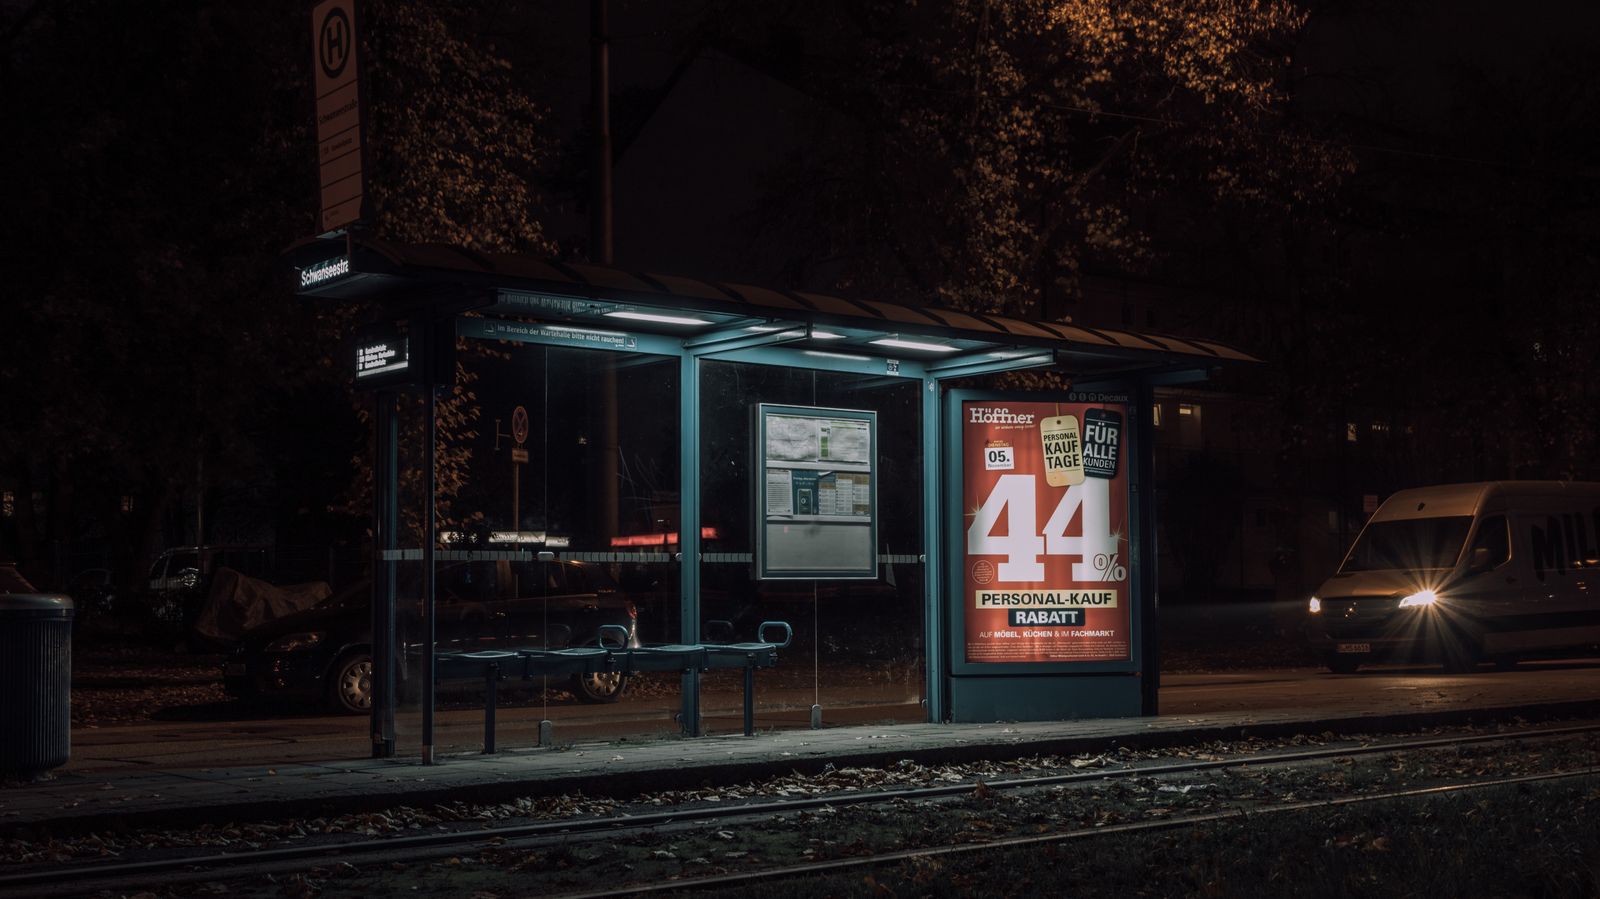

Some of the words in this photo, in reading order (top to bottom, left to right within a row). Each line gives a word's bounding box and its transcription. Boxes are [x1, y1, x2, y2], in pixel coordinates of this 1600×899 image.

[497, 323, 506, 331] Im
[506, 325, 528, 335] Bereich
[529, 327, 539, 335] der
[540, 328, 571, 339] Wartehalle
[572, 332, 585, 340] bitte
[586, 333, 600, 342] nicht
[1098, 393, 1129, 402] Decaux
[969, 408, 1035, 424] Höffner
[1043, 432, 1078, 442] PERSONAL
[1085, 422, 1118, 445] FÜR
[1045, 440, 1078, 456] KAUF
[1083, 443, 1117, 460] ALLE
[988, 450, 1010, 463] 05.
[1046, 454, 1081, 469] TAGE
[1083, 457, 1116, 469] KUNDEN
[981, 593, 1112, 606] PERSONAL-KAUF
[1015, 611, 1078, 624] RABATT
[994, 630, 1021, 639] MÖBEL,
[1022, 630, 1053, 638] KÜCHEN
[1070, 630, 1115, 638] FACHMARKT
